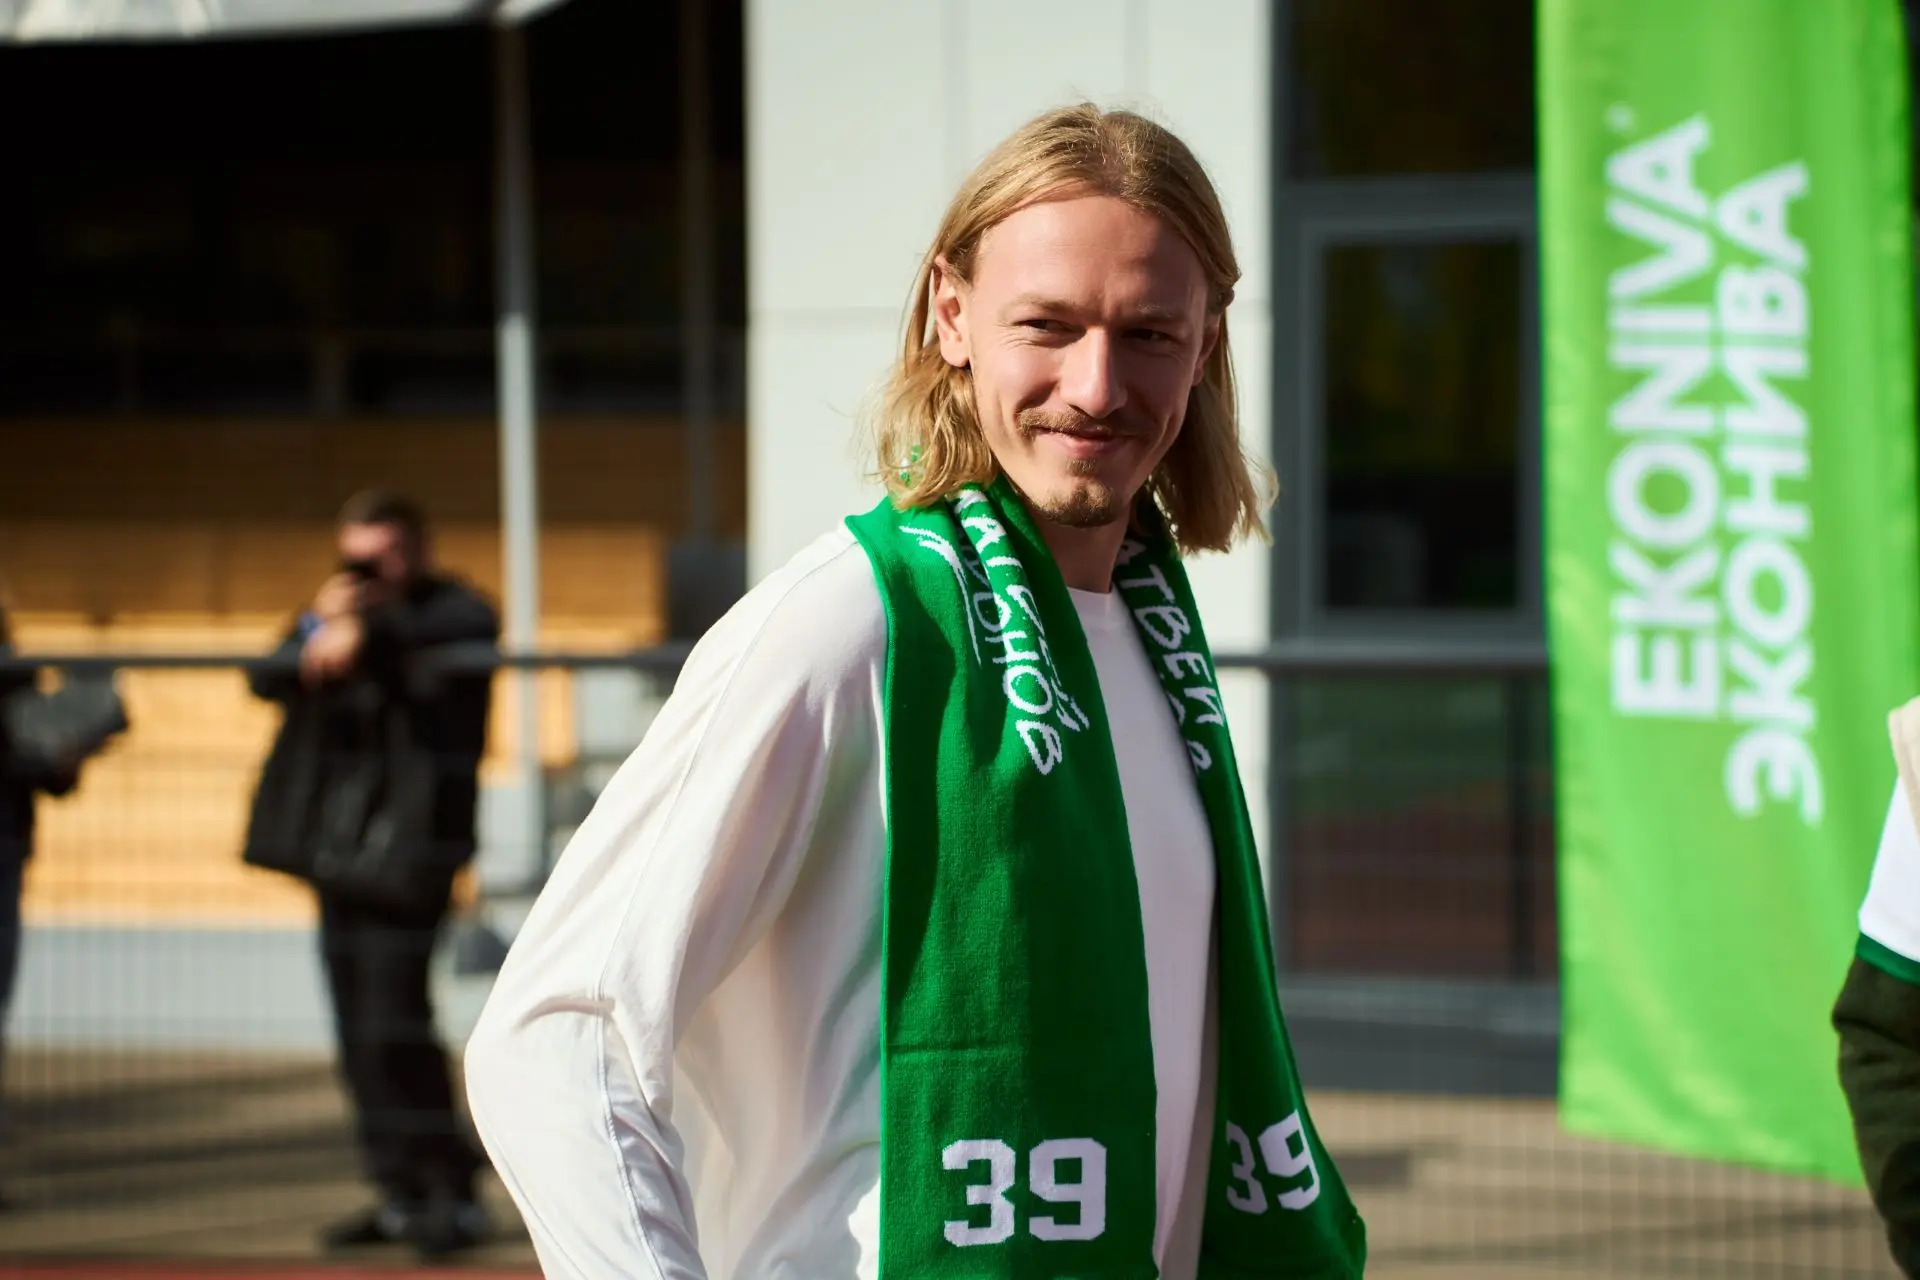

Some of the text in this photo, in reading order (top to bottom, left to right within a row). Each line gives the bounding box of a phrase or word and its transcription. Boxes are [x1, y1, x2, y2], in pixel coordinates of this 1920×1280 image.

[1606, 113, 1720, 717] EKONIVA
[1715, 160, 1824, 825] ЭКОНИВА
[942, 1137, 1107, 1247] 39
[1226, 1108, 1321, 1215] 39
